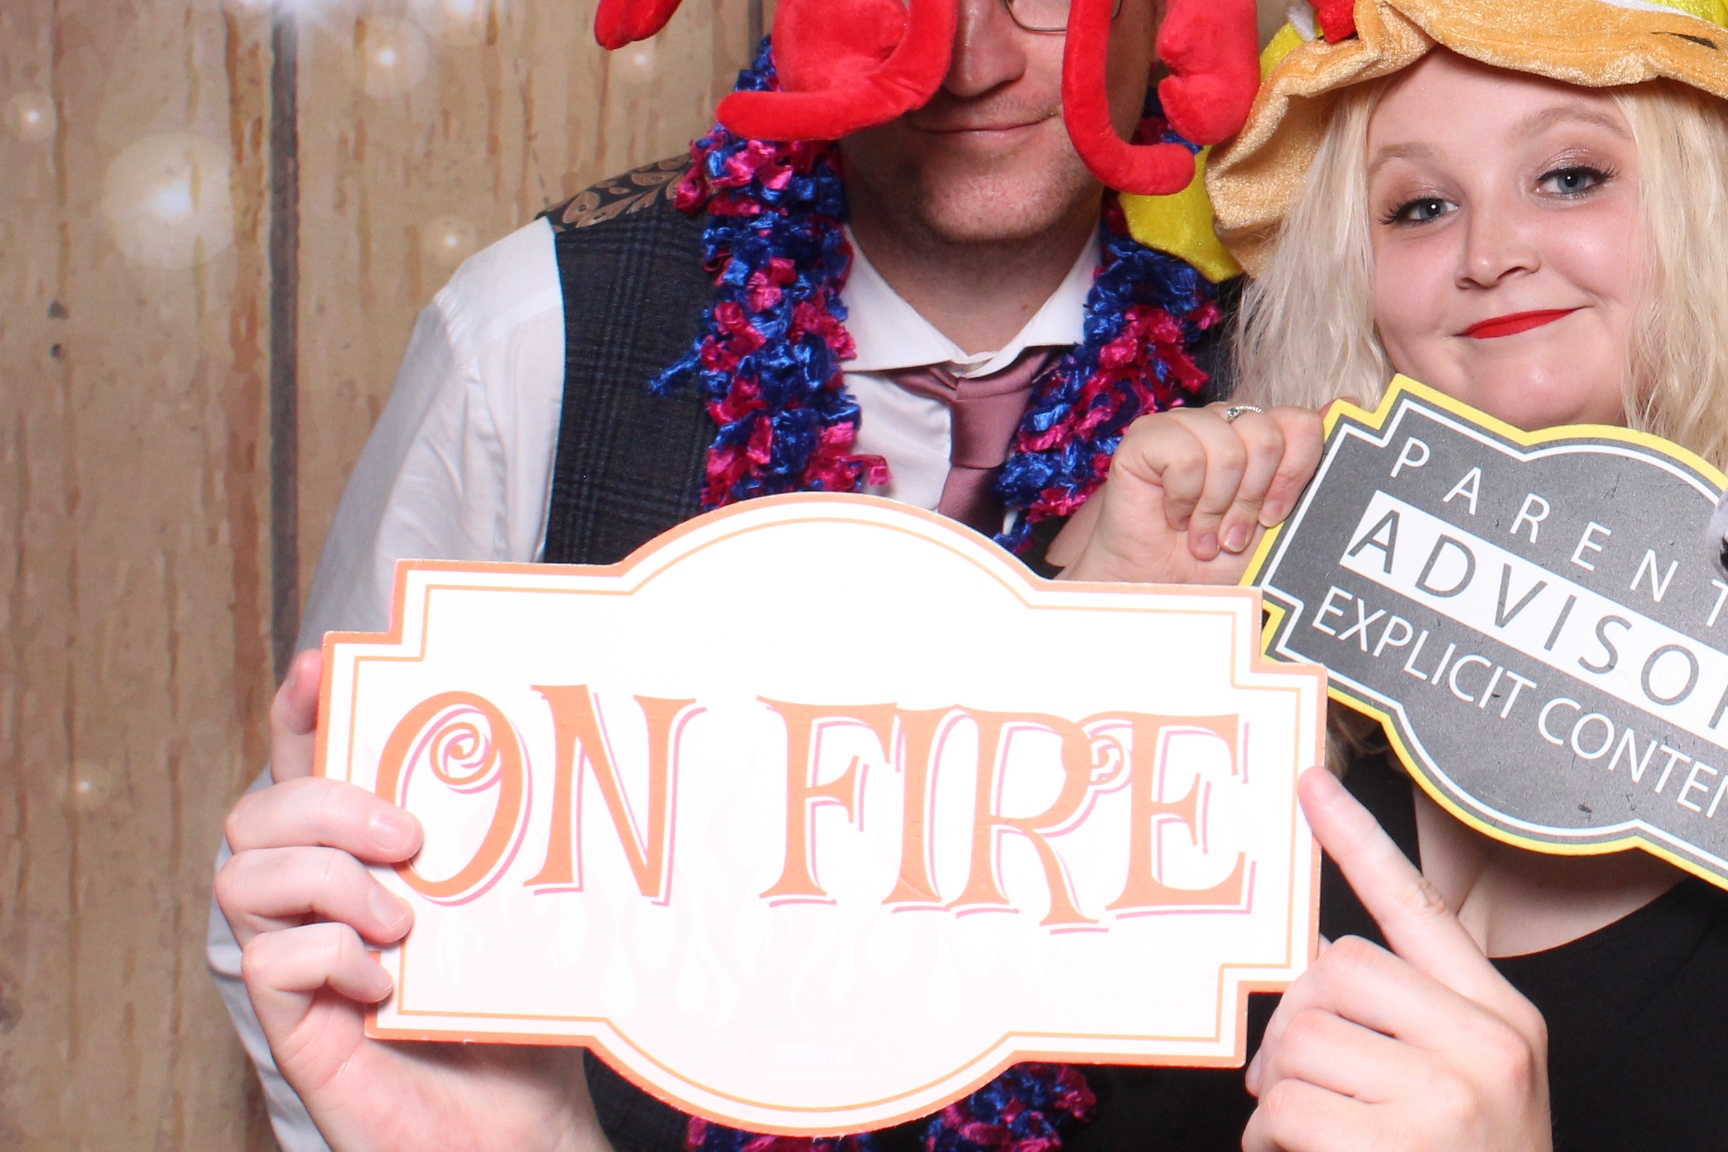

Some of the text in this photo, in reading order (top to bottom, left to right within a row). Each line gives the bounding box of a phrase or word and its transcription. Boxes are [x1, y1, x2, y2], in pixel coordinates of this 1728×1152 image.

[1312, 586, 1538, 720] EXPLICIT
[376, 684, 1256, 936] ON FIRE
